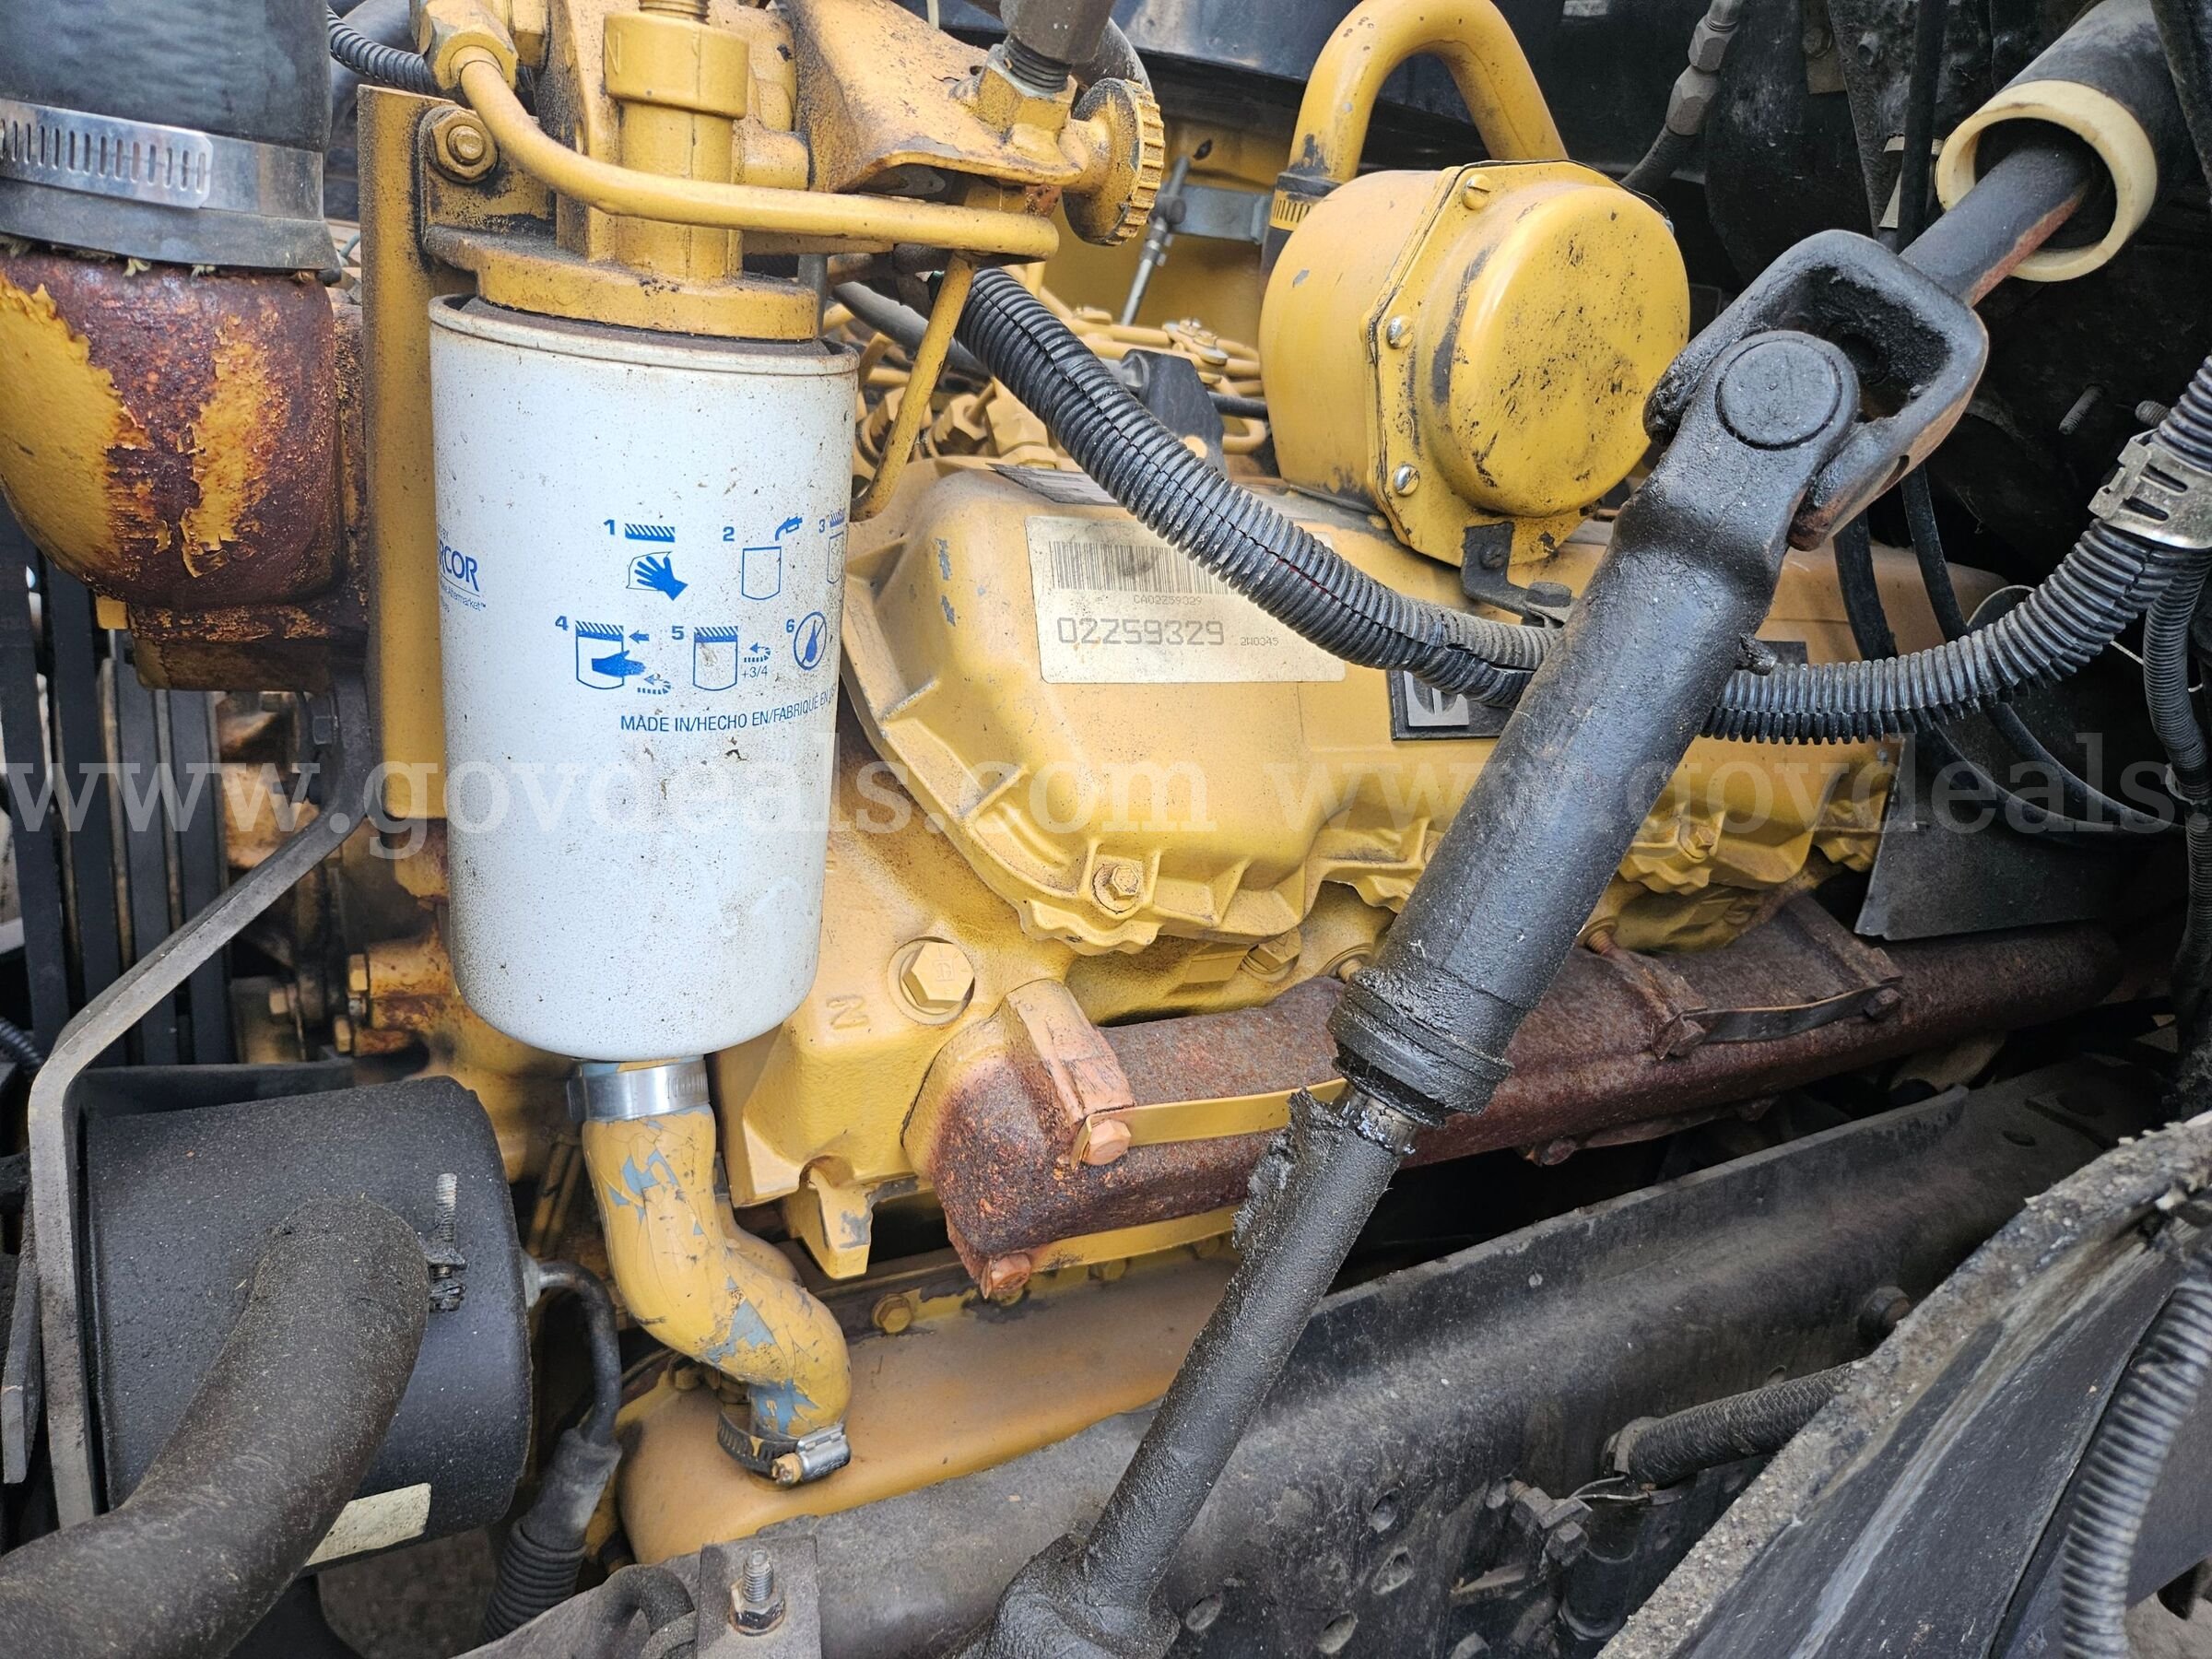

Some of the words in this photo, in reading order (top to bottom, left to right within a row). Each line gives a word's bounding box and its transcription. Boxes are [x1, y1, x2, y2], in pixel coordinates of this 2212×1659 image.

[604, 519, 615, 535] 1
[723, 526, 735, 542] 2
[818, 518, 826, 534] 3
[555, 615, 569, 631] 4
[785, 618, 795, 633] 6
[671, 625, 685, 641] 5
[741, 665, 768, 678] +3/4
[620, 714, 670, 732] MADE
[675, 712, 747, 732] IN/HECHO
